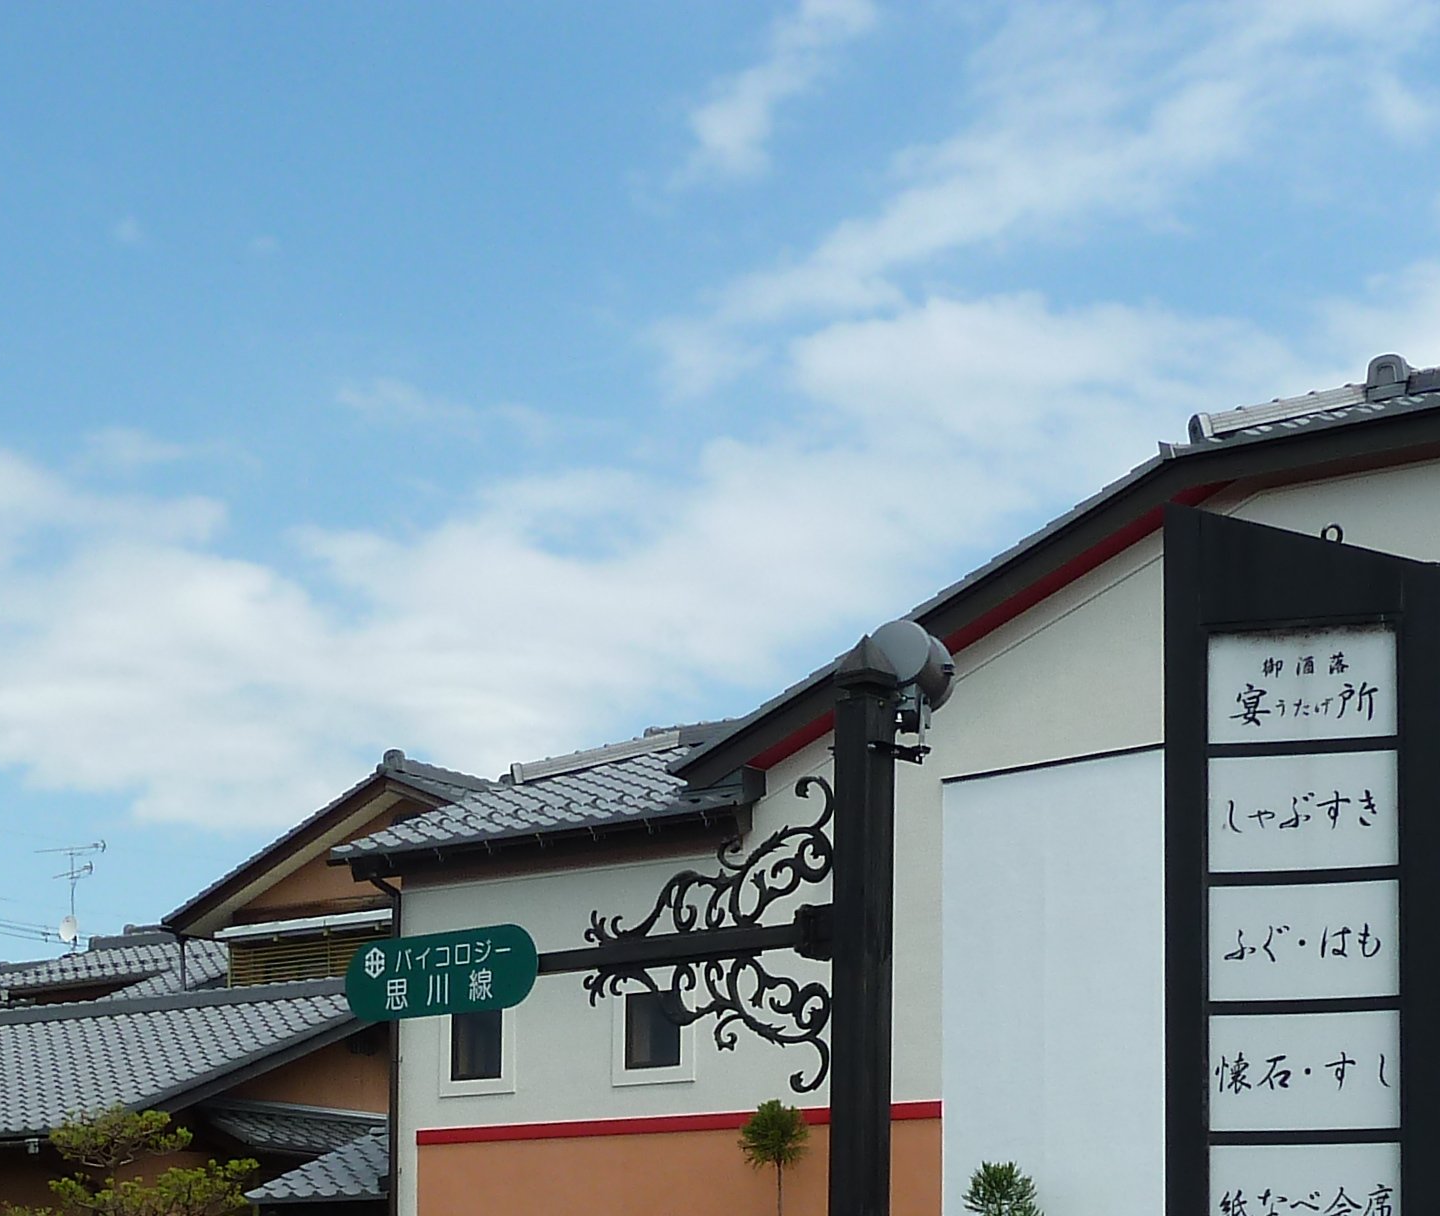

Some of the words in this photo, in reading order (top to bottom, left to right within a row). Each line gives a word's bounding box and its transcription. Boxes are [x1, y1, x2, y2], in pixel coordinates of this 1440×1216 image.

[1225, 788, 1378, 834] しゃぶすき
[395, 938, 511, 973] バイコロジー
[1224, 922, 1382, 963] ふぐ・はも
[385, 967, 493, 1011] 思川線
[1214, 1051, 1391, 1094] 懐石・すし
